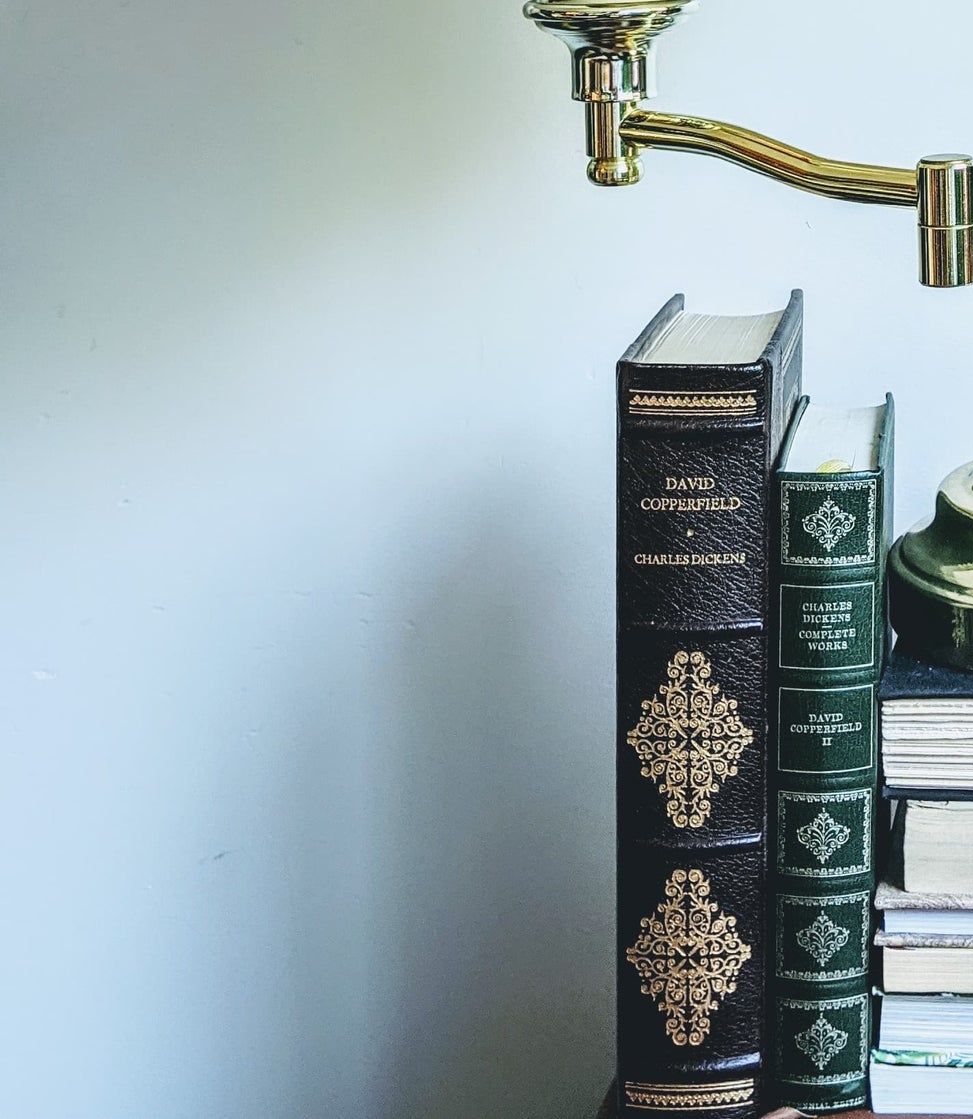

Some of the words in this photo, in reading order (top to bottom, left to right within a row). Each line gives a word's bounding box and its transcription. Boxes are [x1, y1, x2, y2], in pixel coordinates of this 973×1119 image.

[665, 477, 715, 490] DAVID
[640, 497, 741, 511] COPPERFIELD
[634, 554, 690, 565] CHARLES
[691, 552, 746, 565] DICKENS
[802, 601, 853, 612] CHARLES
[803, 613, 851, 623] DICKENS
[798, 628, 857, 640] COMPLETE
[808, 641, 849, 651] WORKS
[808, 713, 844, 723] DAVID
[790, 722, 863, 734] COPPERFIELD
[821, 737, 833, 747] II
